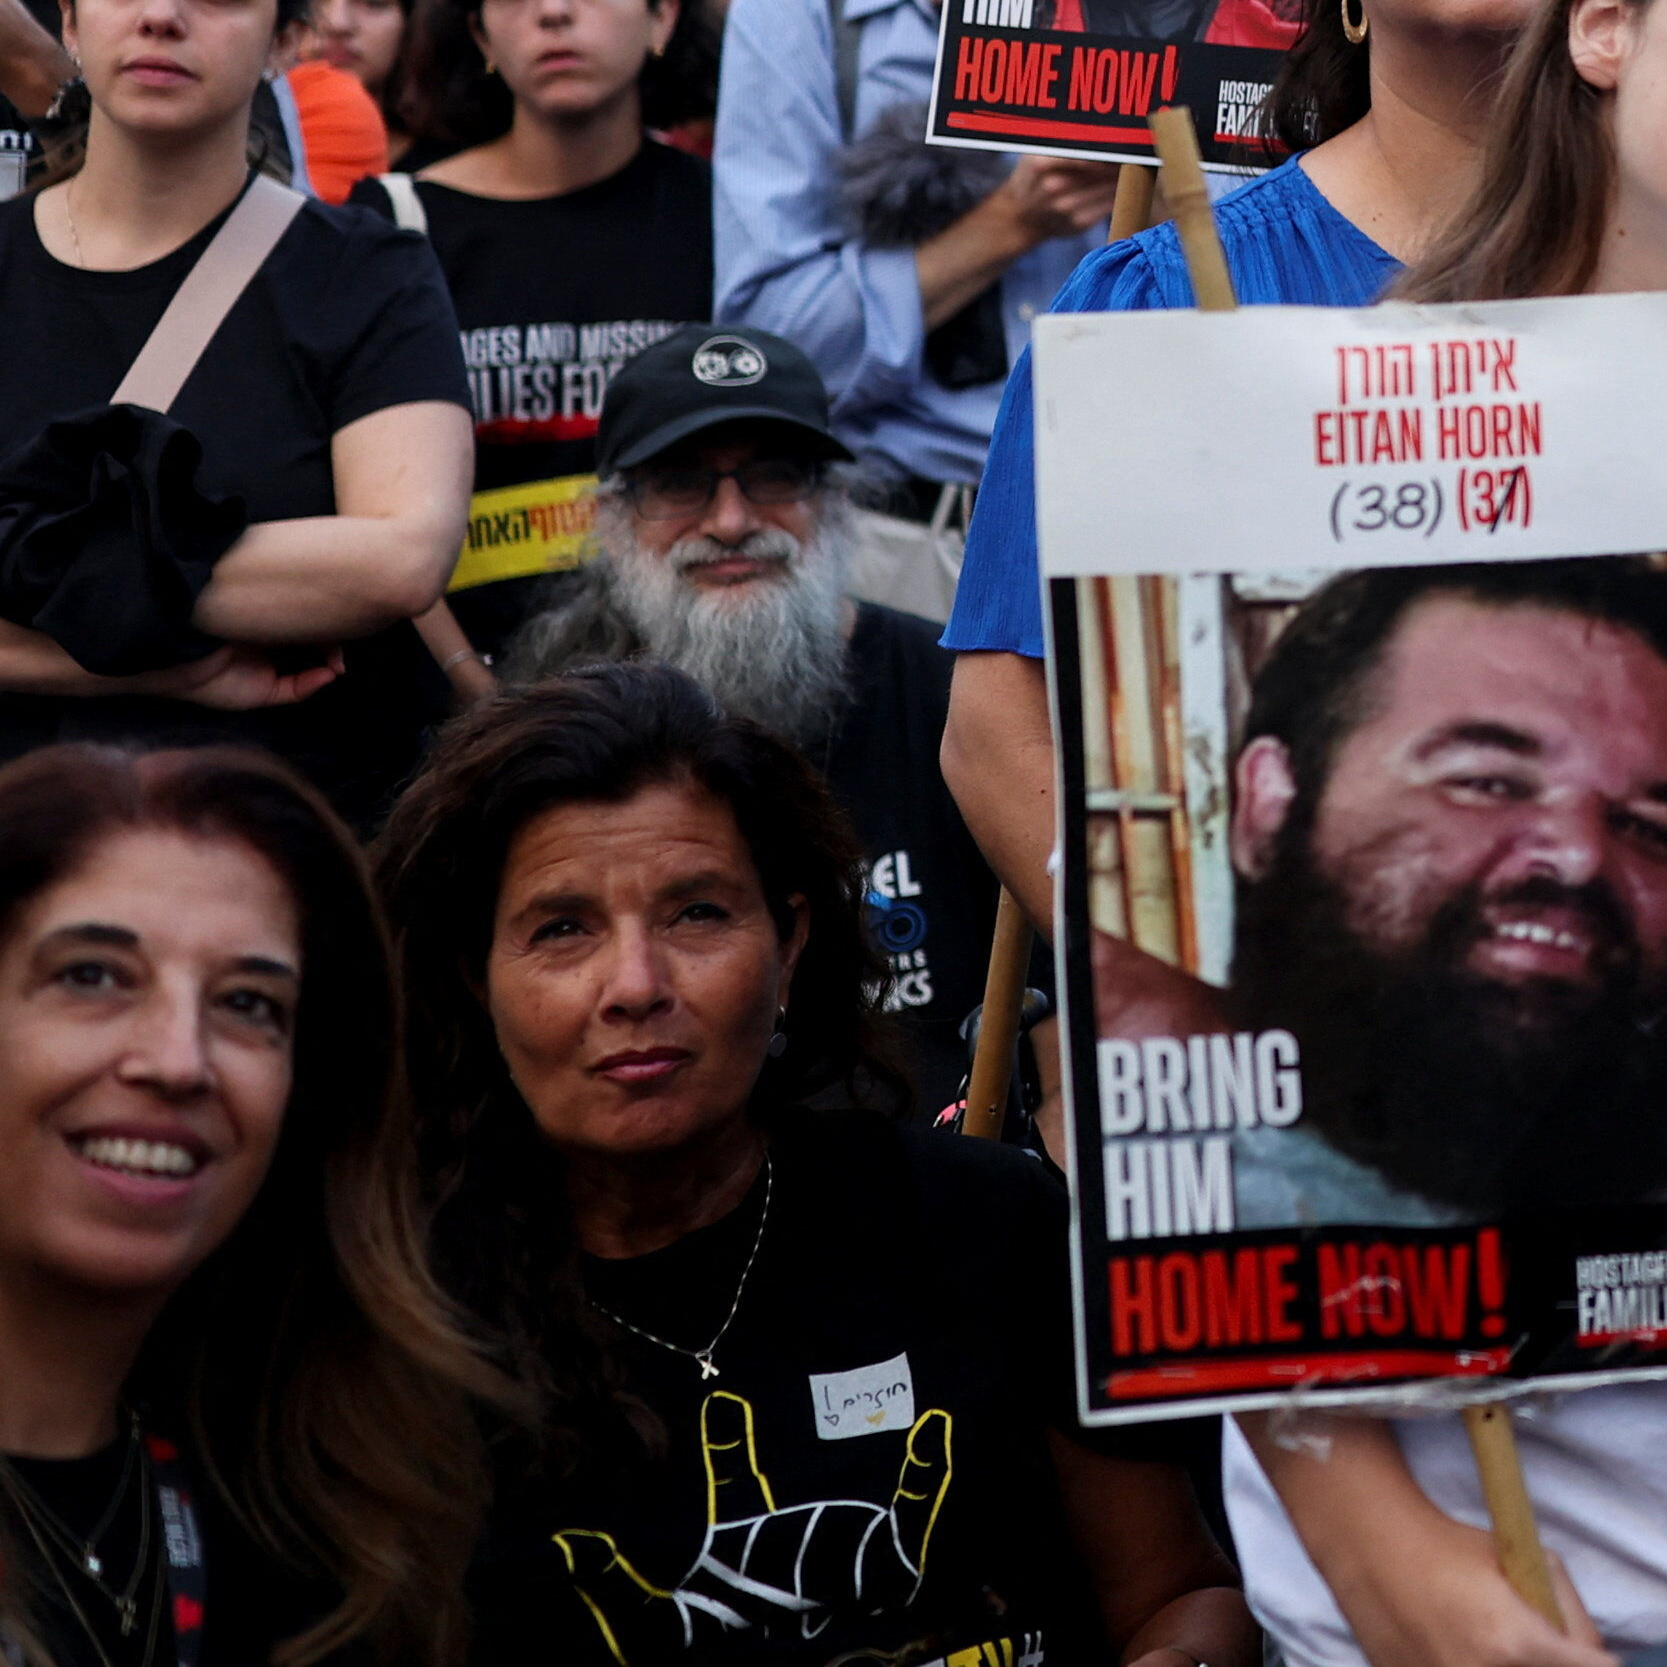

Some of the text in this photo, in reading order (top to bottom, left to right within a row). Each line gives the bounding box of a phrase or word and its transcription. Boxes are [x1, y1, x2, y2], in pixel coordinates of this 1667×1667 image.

[954, 36, 1182, 117] HOME NOW!
[1219, 79, 1275, 106] HOSTAG
[525, 322, 577, 362] AND
[580, 320, 677, 365] MISSI
[1335, 338, 1519, 406] איתן הורן
[1314, 401, 1542, 467] EITAN HORN
[1330, 477, 1445, 543] (38)
[1458, 465, 1533, 533] (37)
[1096, 1029, 1304, 1137] BRING
[1102, 1136, 1236, 1242] HIM
[1108, 1227, 1508, 1356] HOME NOW!
